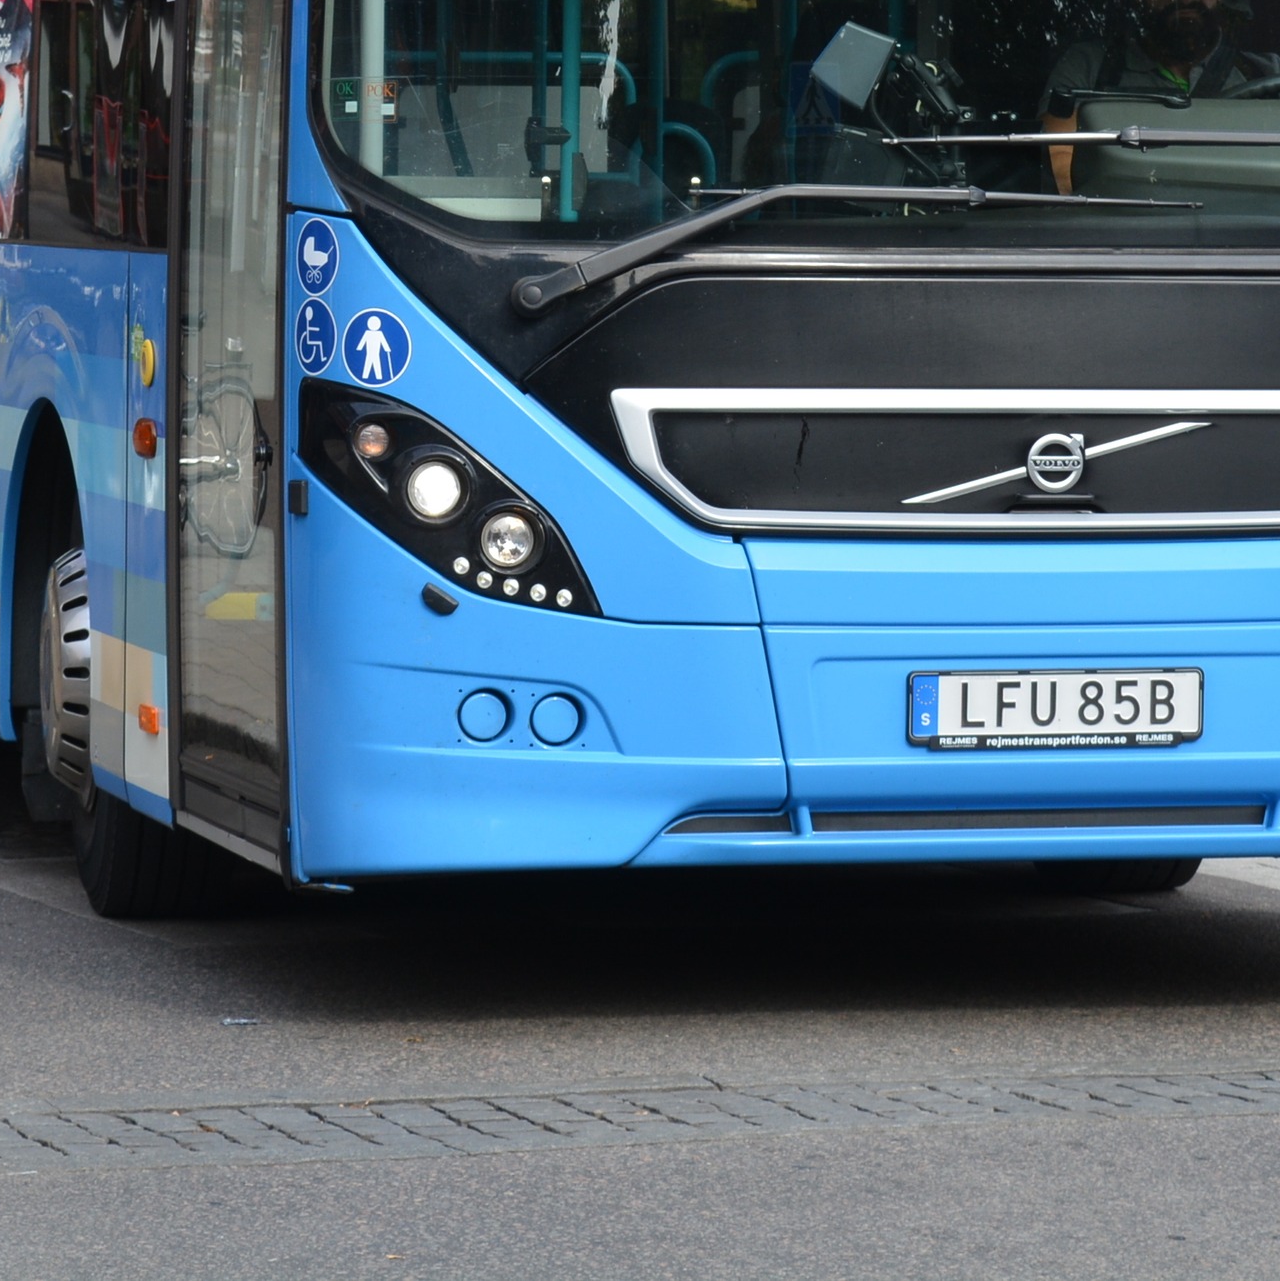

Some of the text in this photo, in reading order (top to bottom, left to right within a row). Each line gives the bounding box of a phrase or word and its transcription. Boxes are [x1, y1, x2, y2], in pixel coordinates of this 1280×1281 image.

[336, 82, 355, 96] OK
[367, 84, 395, 97] POK
[1030, 457, 1082, 469] VOLVO
[960, 679, 1176, 728] LFU 85B
[920, 713, 931, 726] S
[939, 736, 978, 746] REJMES
[986, 734, 1127, 747] rejmestransportfordon.se
[1135, 733, 1174, 744] REJMES
